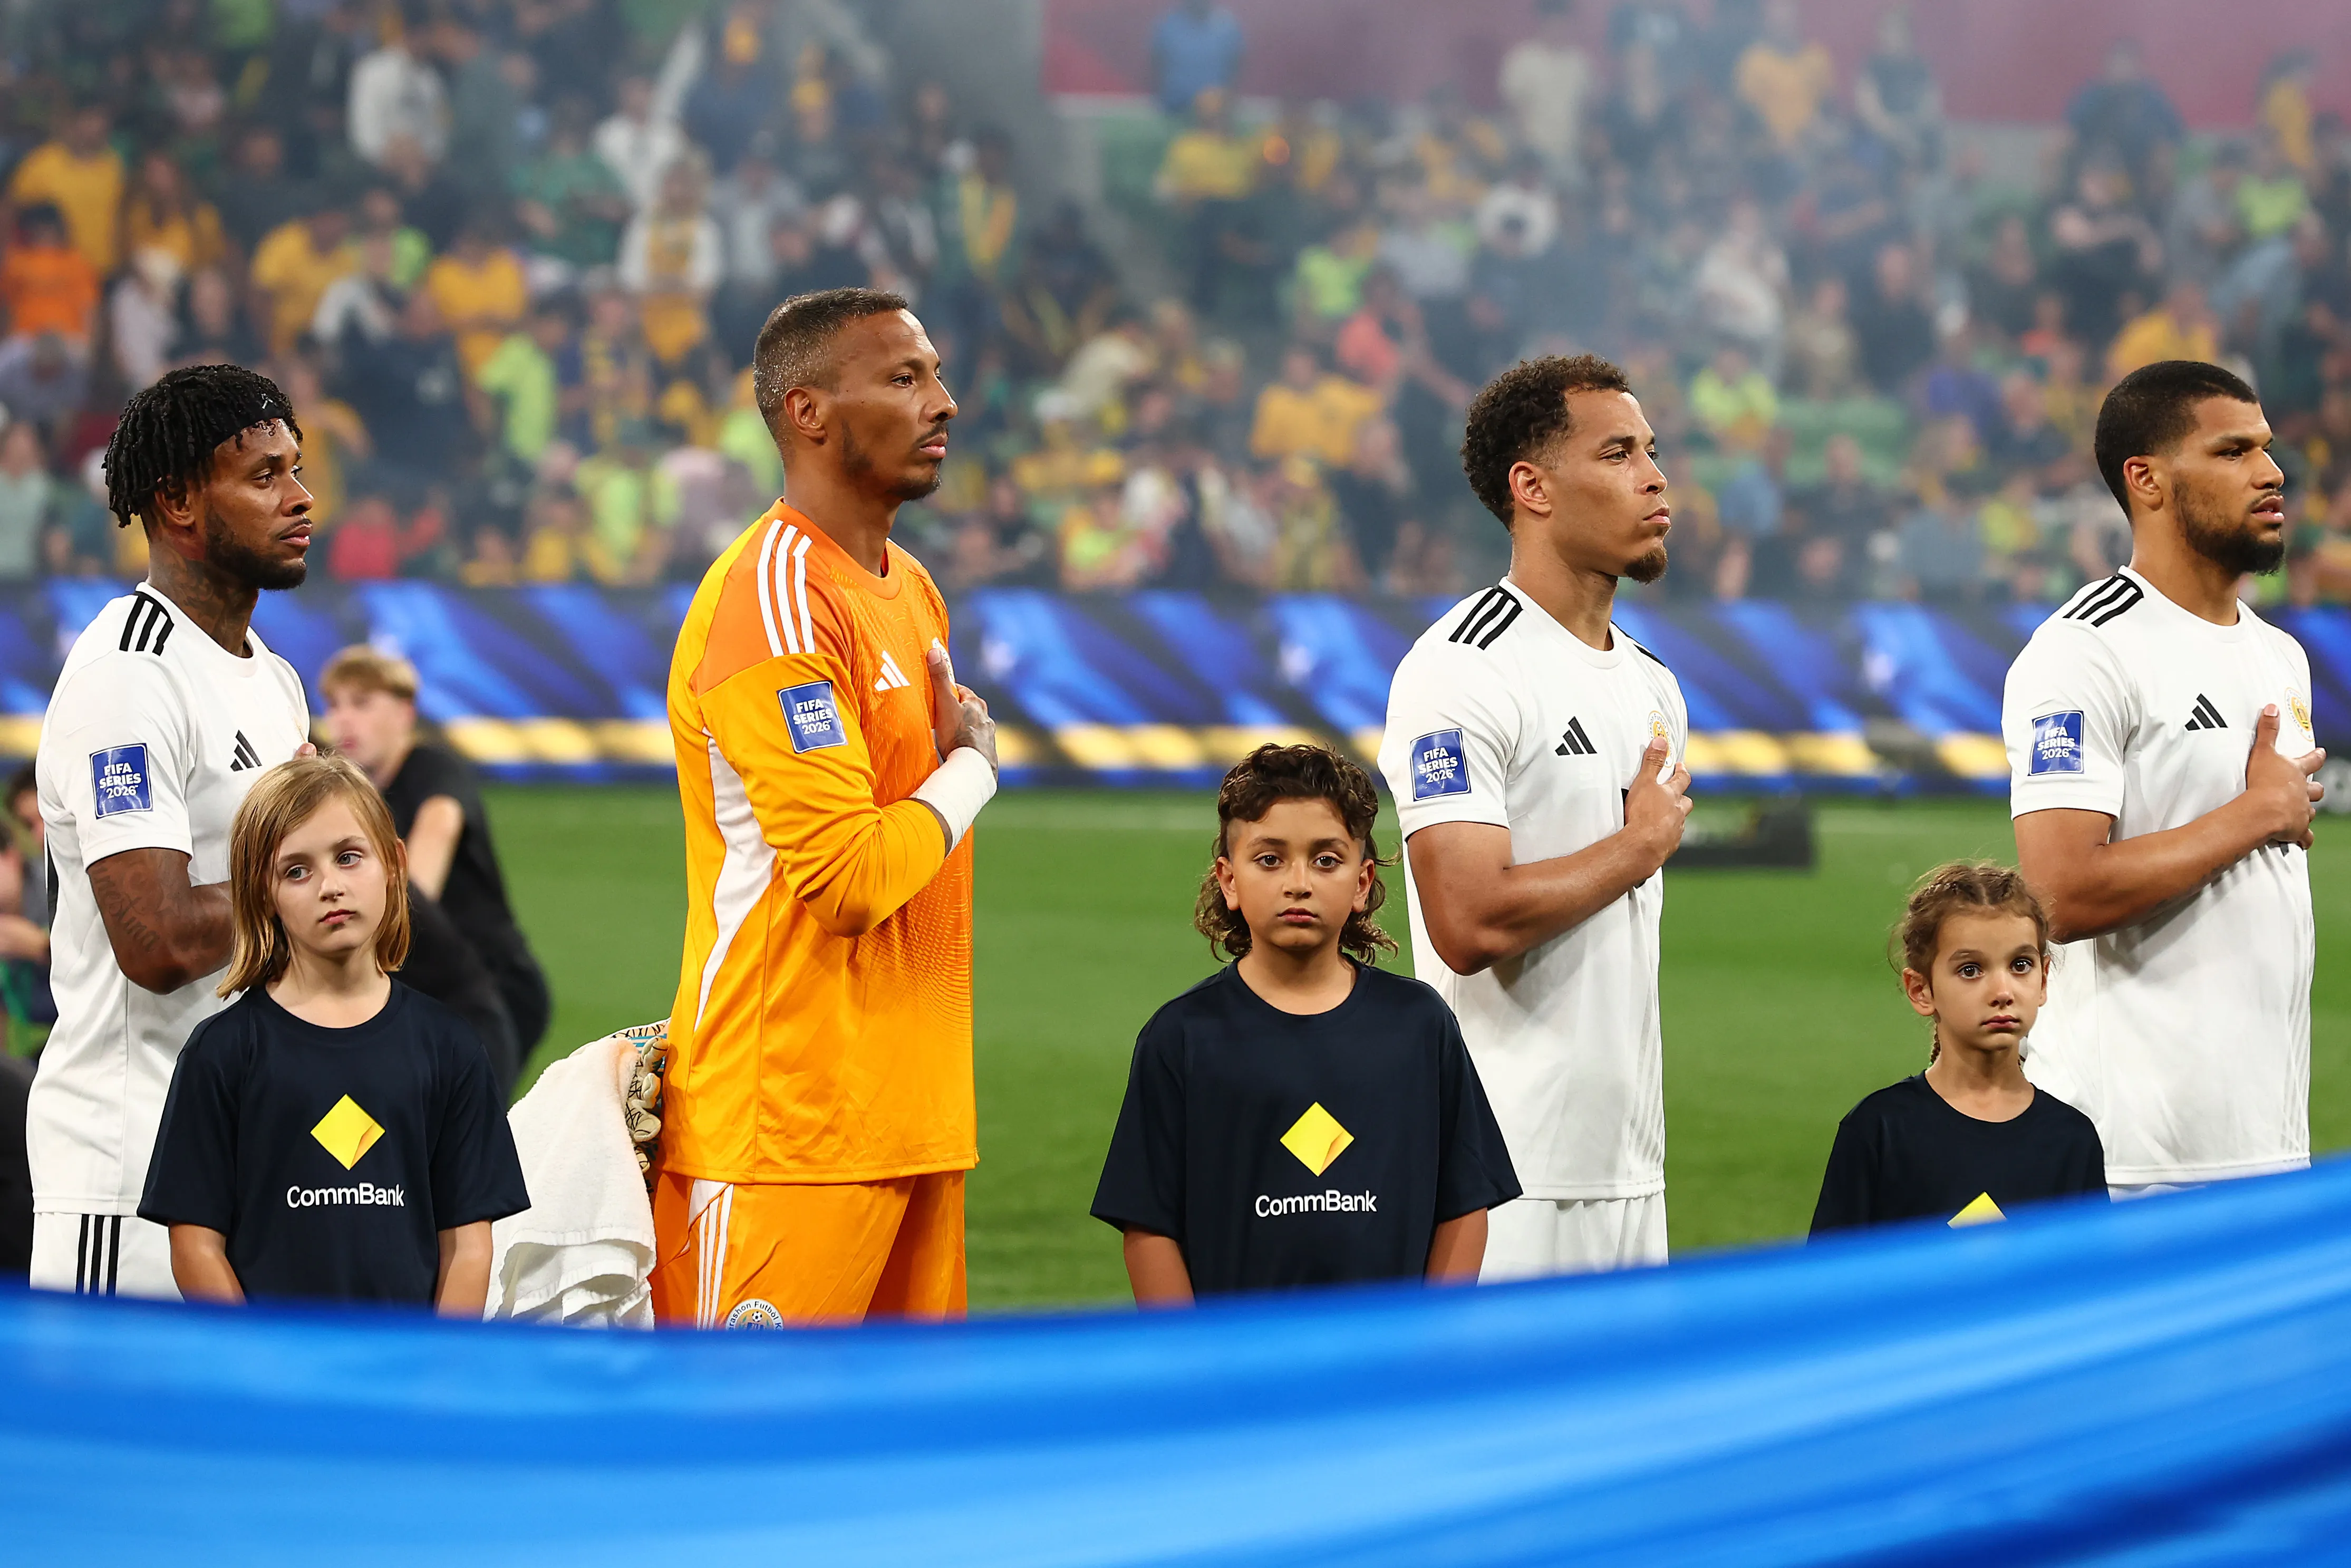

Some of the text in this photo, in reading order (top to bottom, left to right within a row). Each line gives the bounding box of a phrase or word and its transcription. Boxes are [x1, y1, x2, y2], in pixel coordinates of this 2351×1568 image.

[796, 698, 824, 713] FIFA
[792, 708, 833, 725] SERIES
[2044, 727, 2068, 740] FIFA
[2037, 737, 2075, 751] SERIES
[1423, 747, 1449, 762] FIFA
[104, 762, 132, 776] FIFA
[1417, 757, 1458, 774] SERIES
[99, 773, 142, 789] SERIES
[287, 1182, 404, 1208] CommBank
[1255, 1189, 1377, 1217] CommBank
